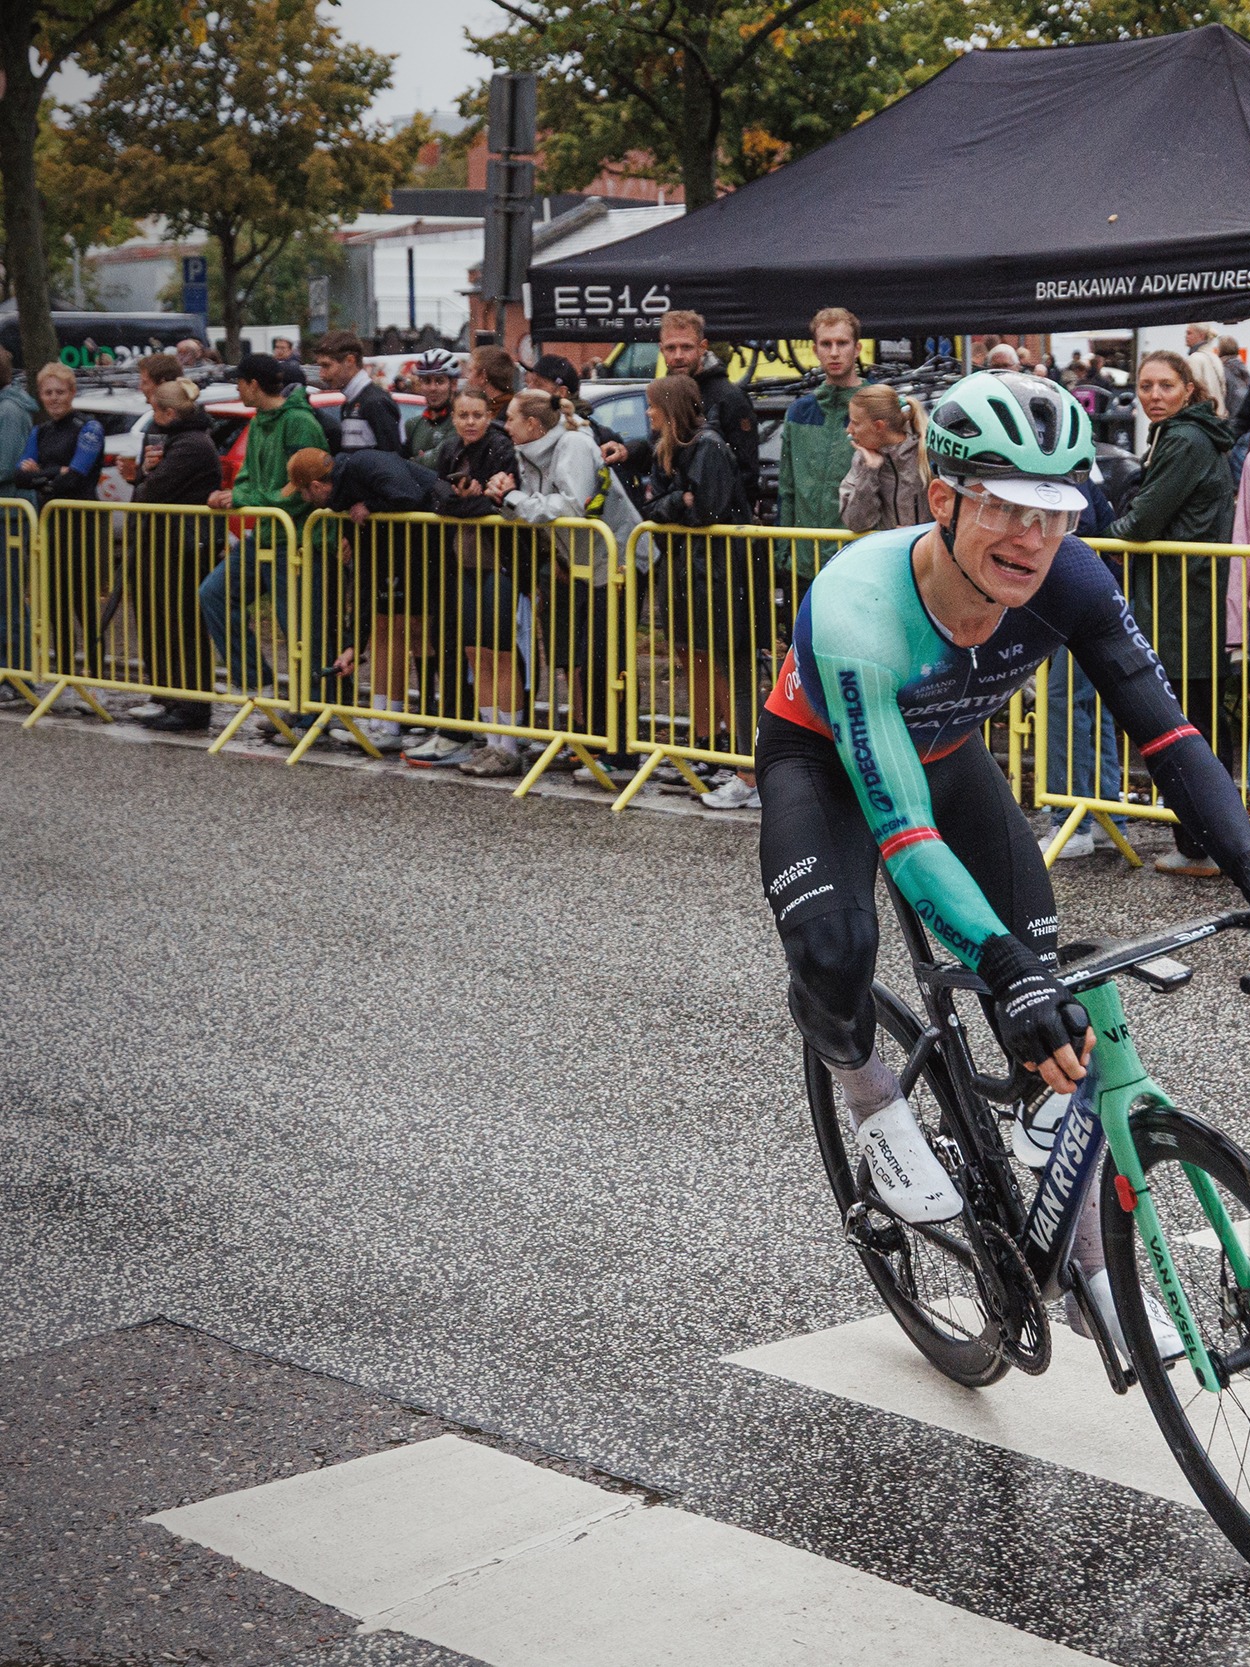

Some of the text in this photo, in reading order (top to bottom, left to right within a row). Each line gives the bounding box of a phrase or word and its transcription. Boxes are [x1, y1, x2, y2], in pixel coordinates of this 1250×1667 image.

[188, 258, 203, 282] P
[554, 284, 671, 315] ES16
[1036, 276, 1136, 299] BREAKAWAY
[555, 317, 662, 328] BITE THE DUS
[914, 679, 957, 696] ARMAND
[978, 671, 1007, 684] VAN
[915, 686, 950, 700] THIERY
[839, 670, 882, 788] DECATHLON
[769, 856, 817, 894] ARMAND
[774, 864, 813, 895] THIERY
[785, 883, 834, 912] DECATHLON
[1027, 915, 1058, 930] ARMAN
[1032, 924, 1058, 937] THIER
[864, 1144, 896, 1190] CMA CGM
[877, 1138, 912, 1188] DECATHLON
[1029, 1105, 1094, 1253] VAN RYSEL
[1150, 1235, 1172, 1285] VAN
[1168, 1291, 1197, 1360] RYSEL
